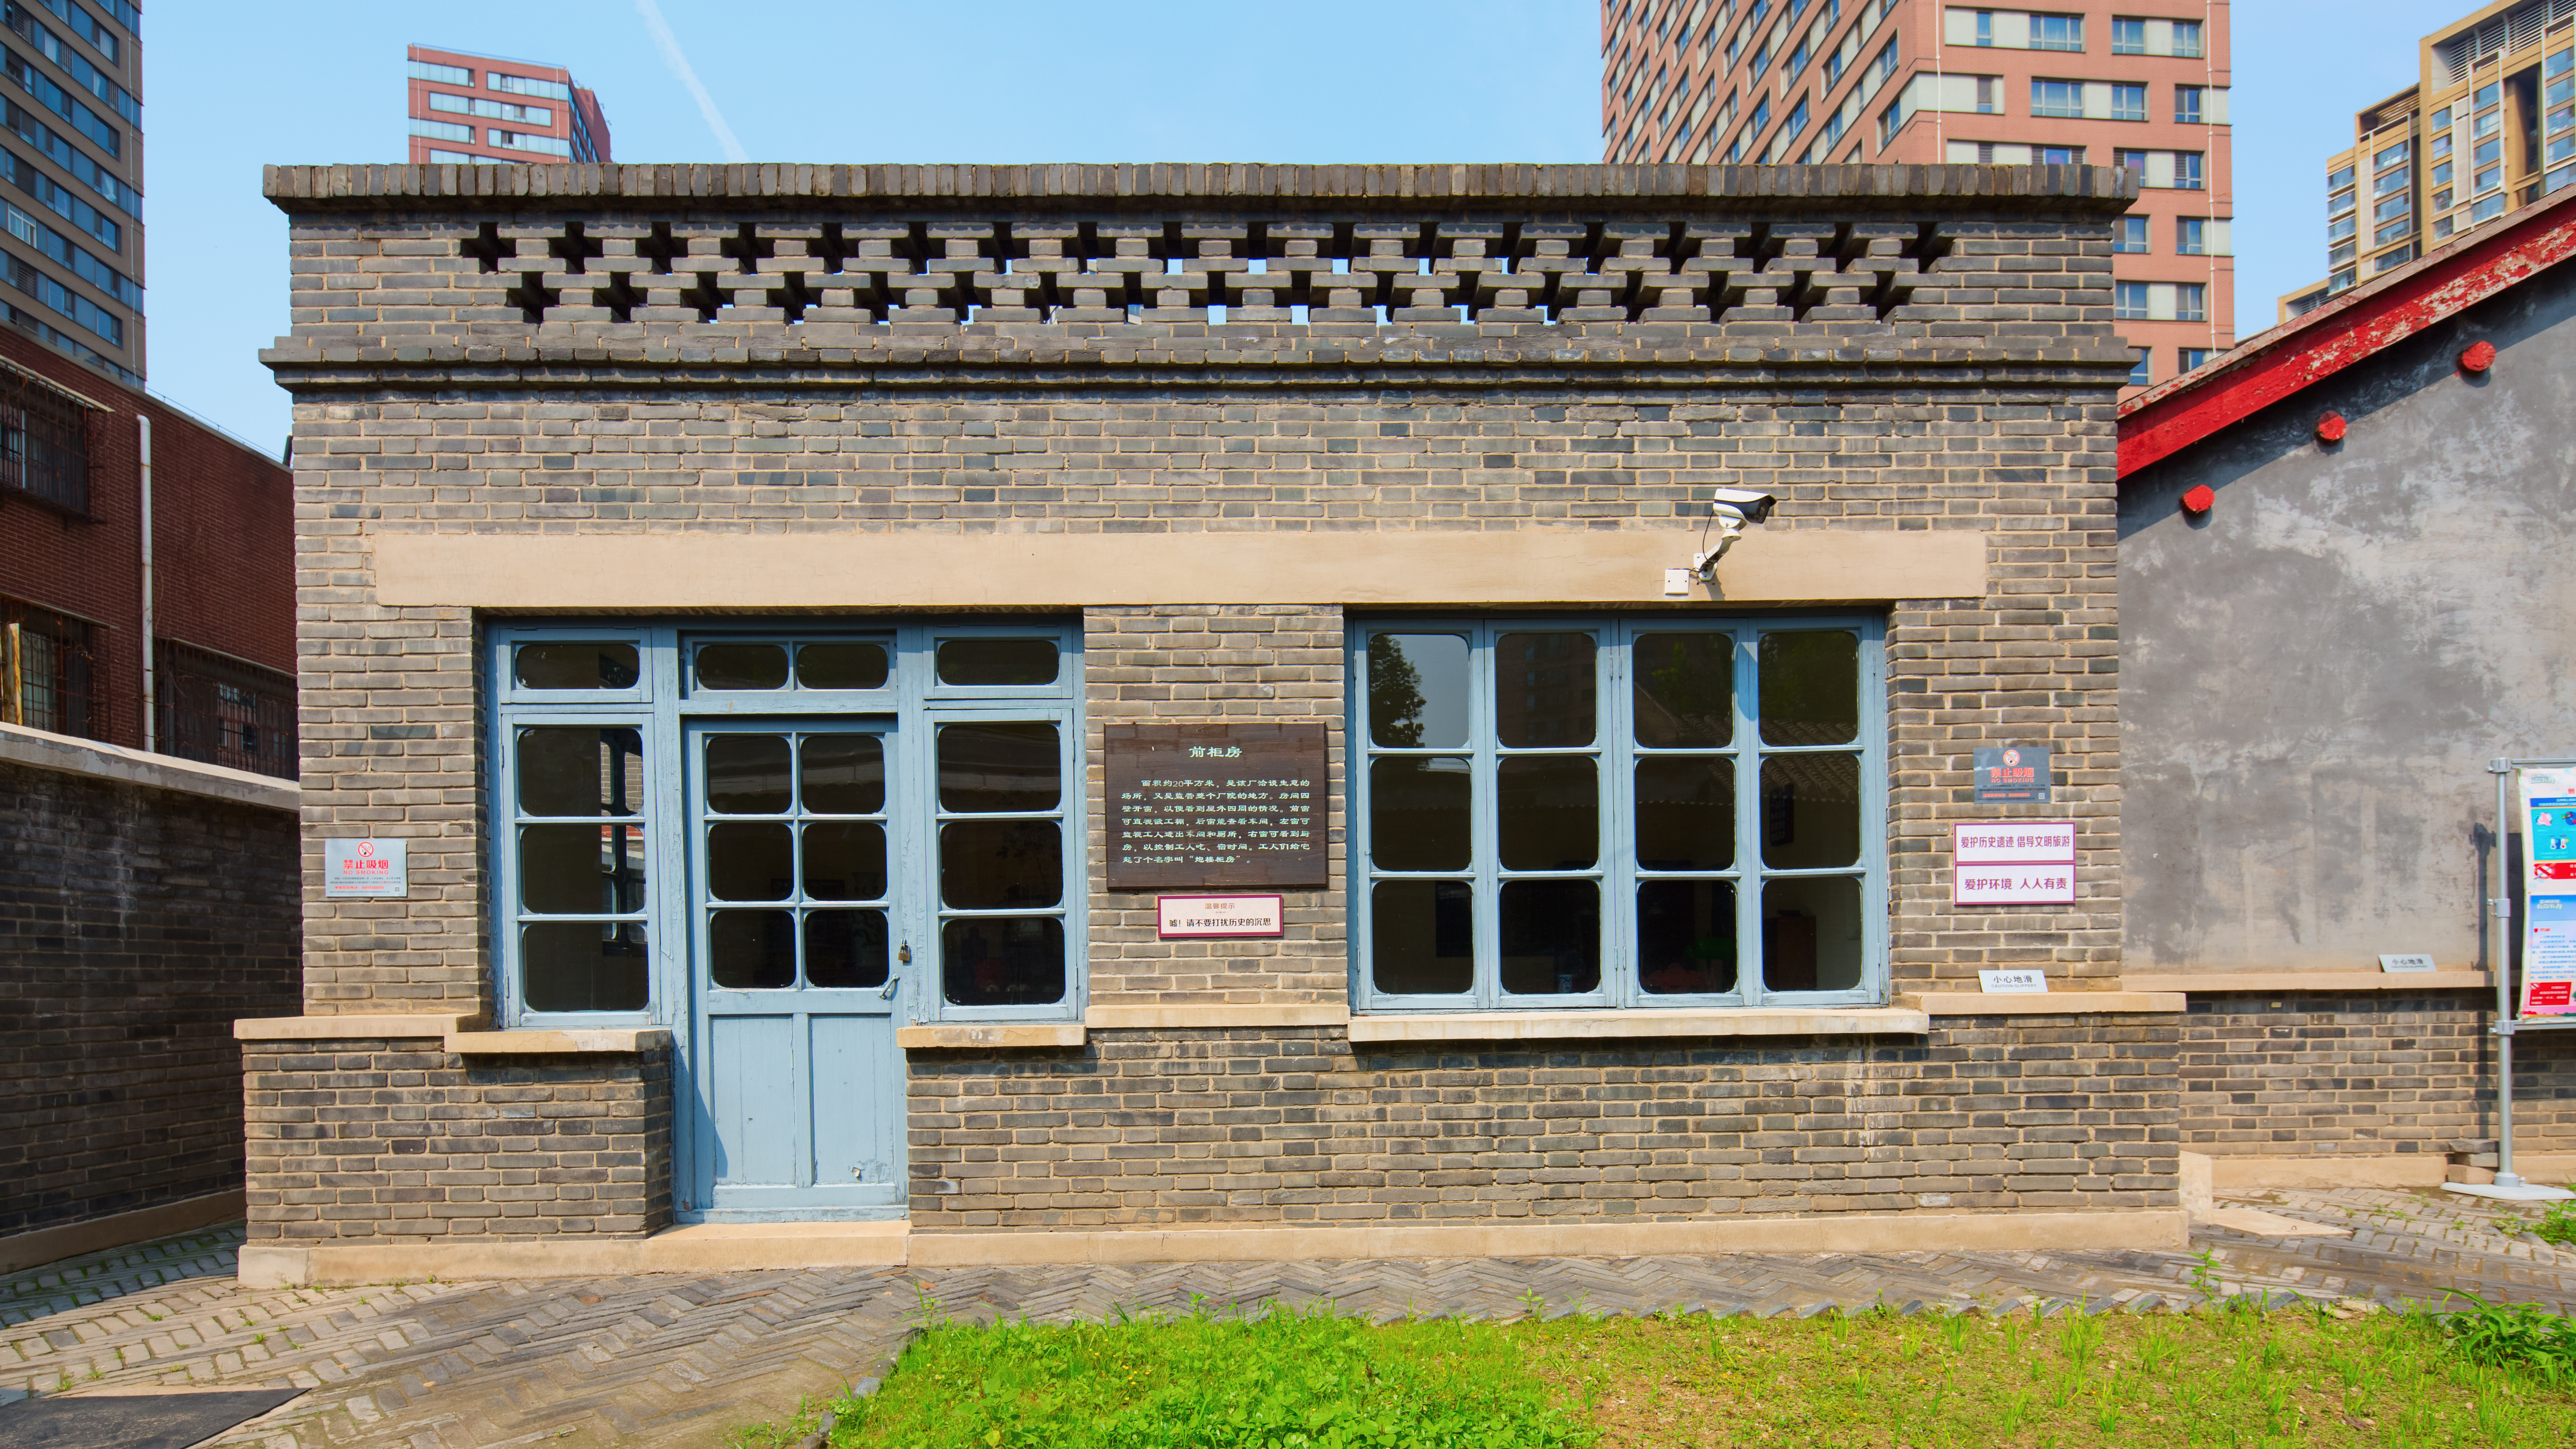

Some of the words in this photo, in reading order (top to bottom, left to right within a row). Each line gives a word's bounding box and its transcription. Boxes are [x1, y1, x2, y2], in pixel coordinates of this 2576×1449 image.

[1189, 746, 1242, 758] 前柜房
[1991, 767, 2034, 778] 禁止吸烟
[1961, 836, 2014, 848] 爱护历史遗迹
[2017, 835, 2070, 847] 倡导文明旅游
[343, 860, 389, 869] 禁止吸烟
[1965, 879, 2012, 890] 爱护环境
[2020, 878, 2067, 889] 人人有责
[1169, 918, 1271, 927] 嘘！请不要打扰历史的沉思
